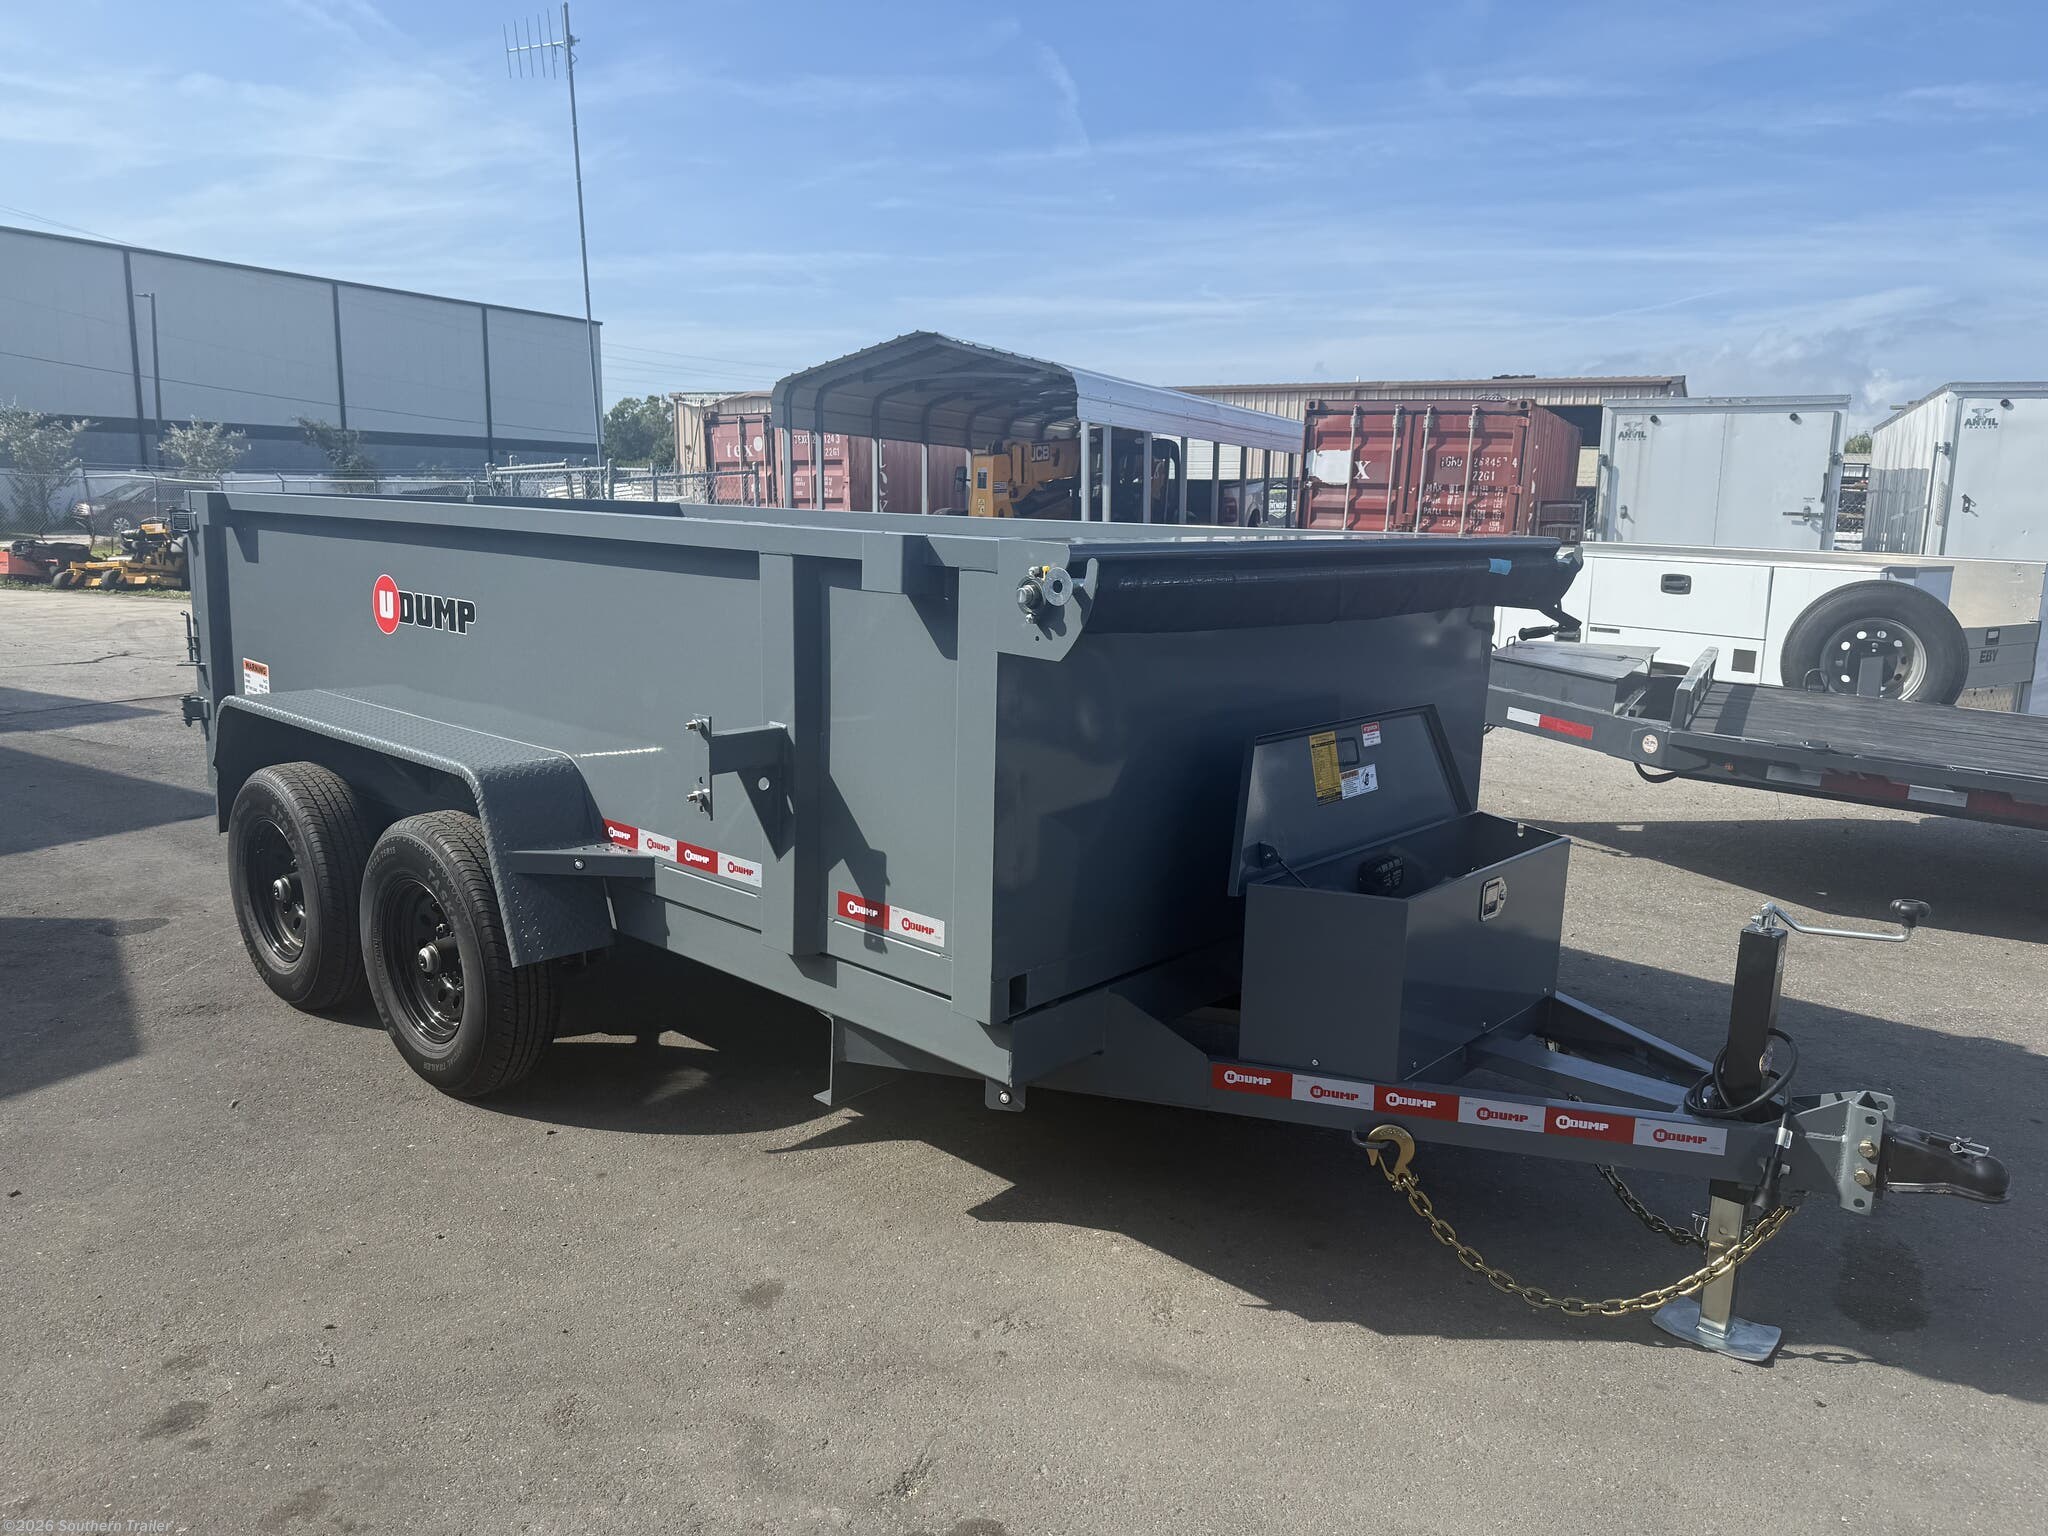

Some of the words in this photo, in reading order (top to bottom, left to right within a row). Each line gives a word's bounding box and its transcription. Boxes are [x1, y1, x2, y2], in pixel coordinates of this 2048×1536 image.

[1964, 417, 1999, 428] ANVIL
[1618, 431, 1647, 440] ANVIL
[1031, 445, 1050, 461] JCB
[1979, 648, 1999, 664] EBY
